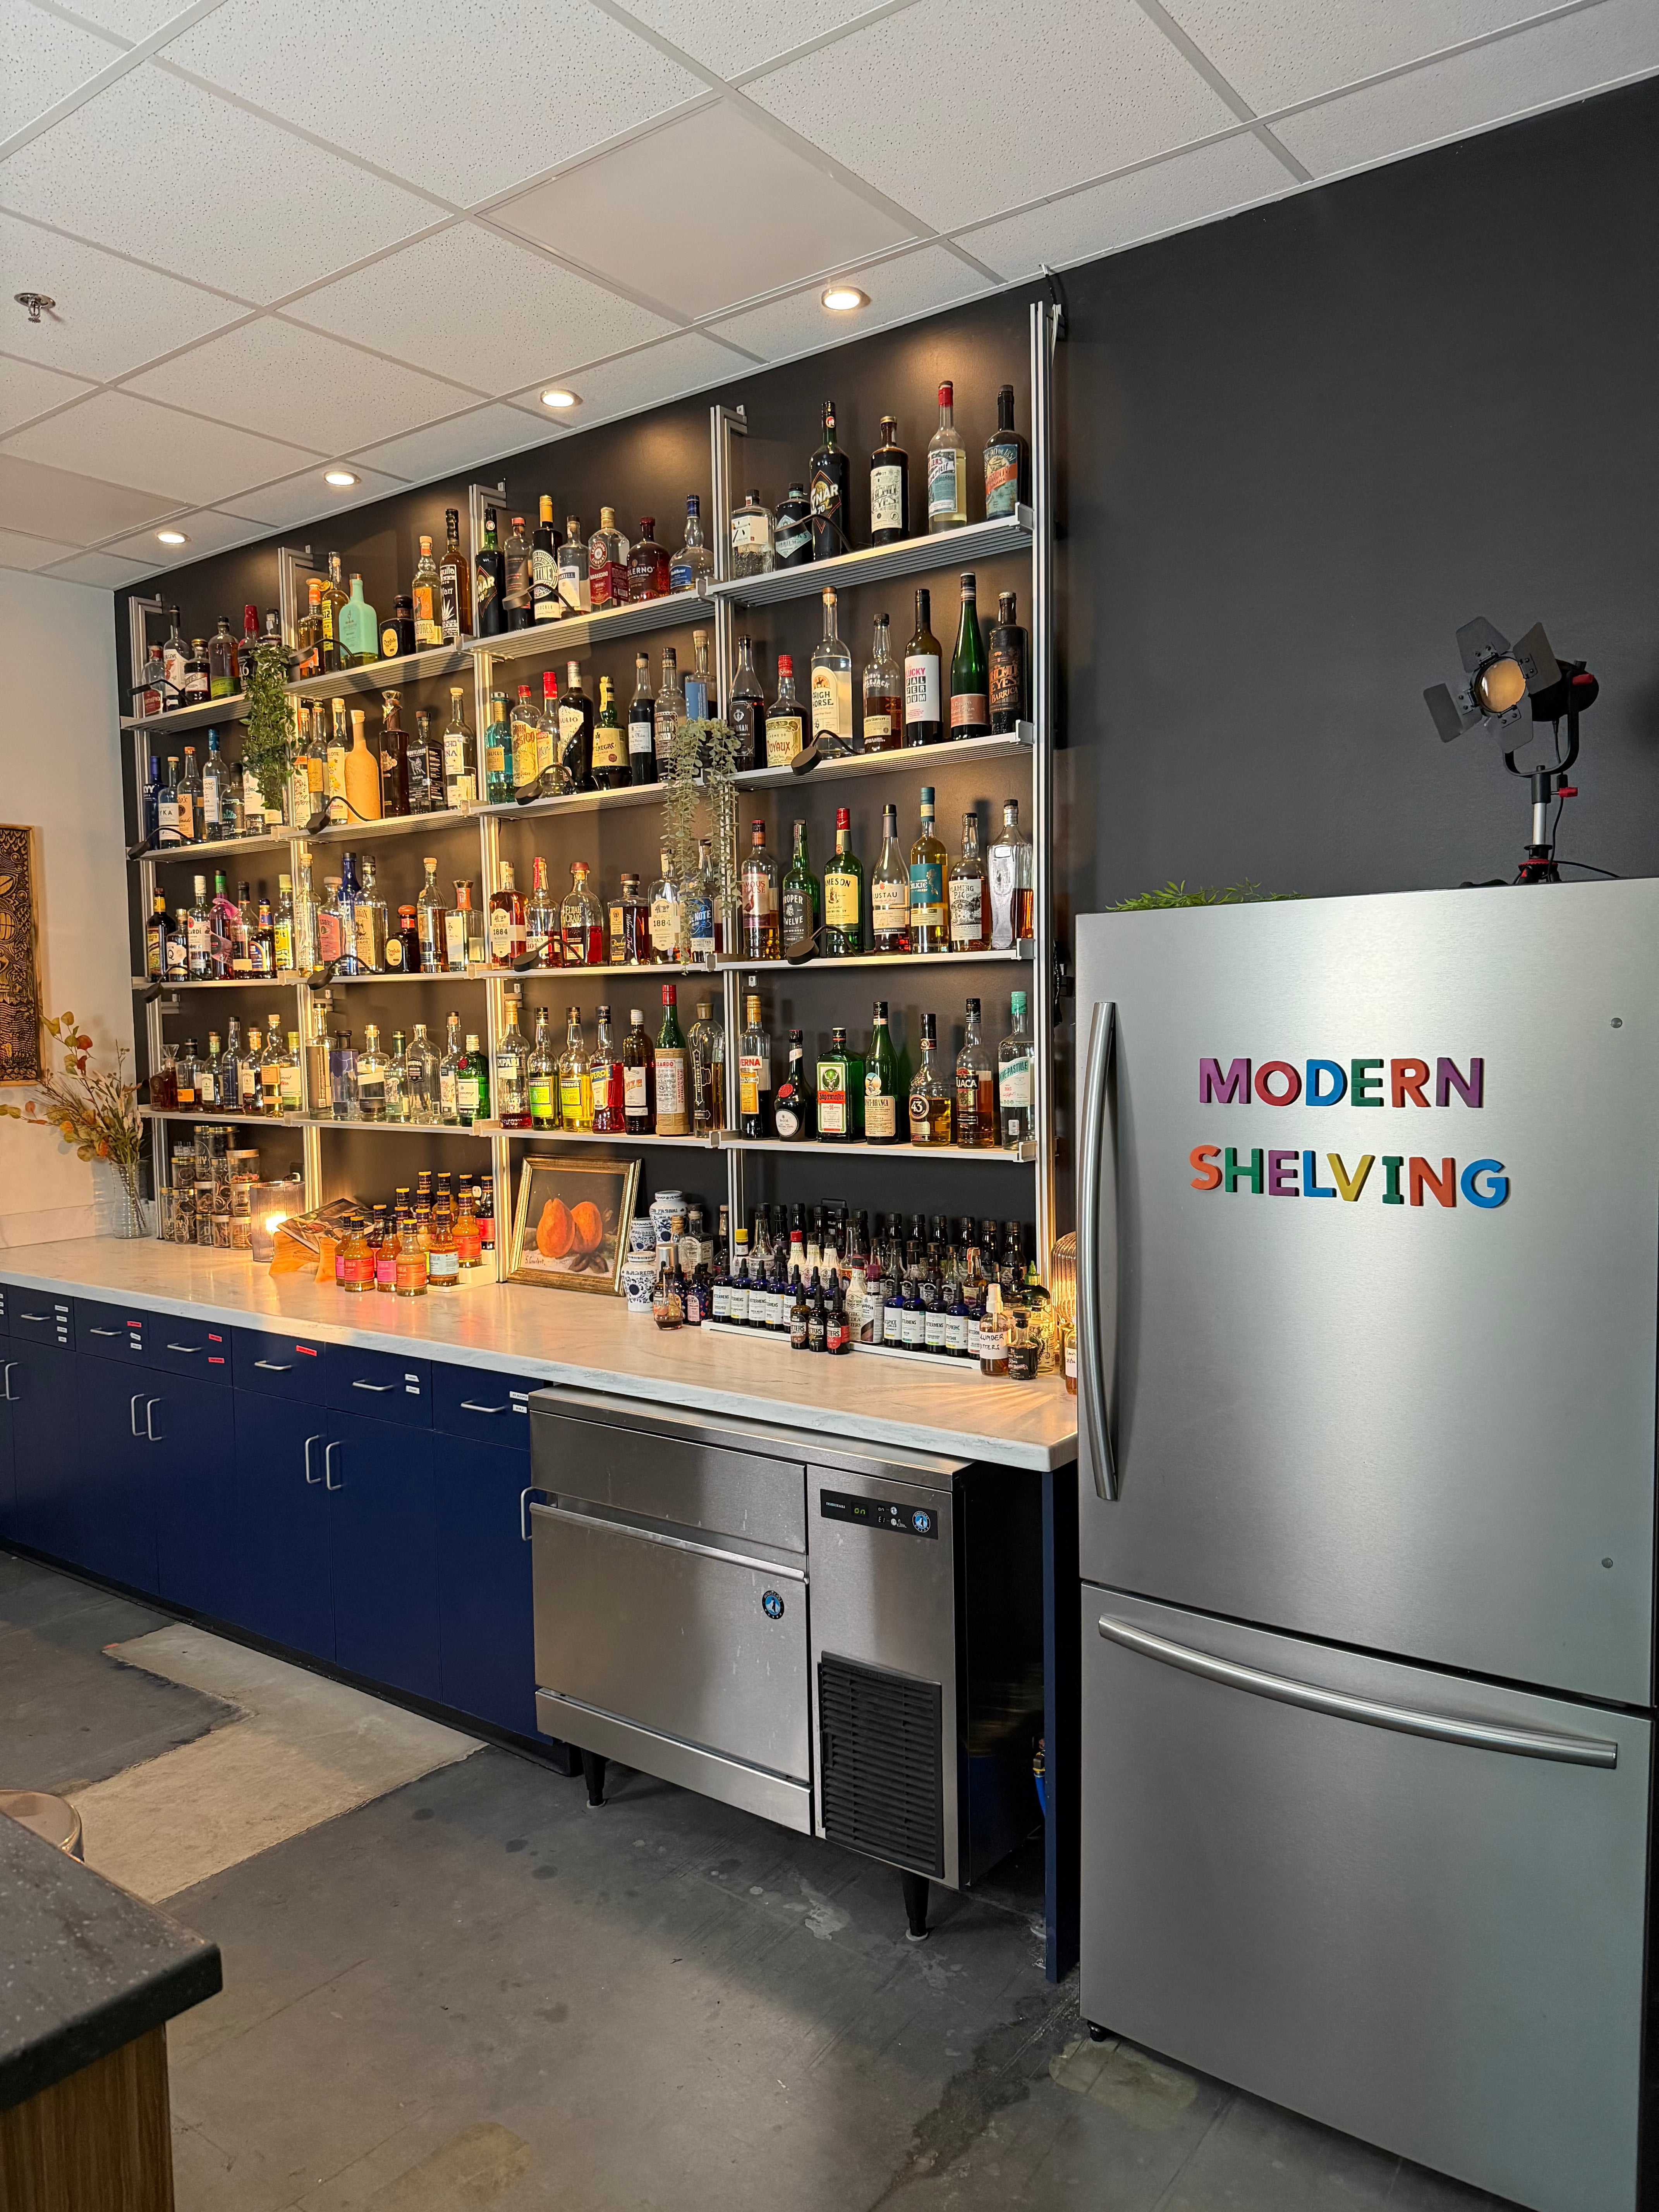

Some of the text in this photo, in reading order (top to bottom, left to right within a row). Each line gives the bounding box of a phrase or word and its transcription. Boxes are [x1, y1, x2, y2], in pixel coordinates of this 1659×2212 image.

[813, 691, 830, 700] HIGH
[992, 686, 1018, 704] BARRICA
[954, 891, 967, 899] PIG
[565, 914, 582, 922] CRAIG
[694, 910, 711, 921] NOTE
[168, 949, 175, 960] Q
[1199, 1058, 1483, 1108] MODERN
[910, 1101, 923, 1113] 43
[1189, 1144, 1509, 1208] SHELVING
